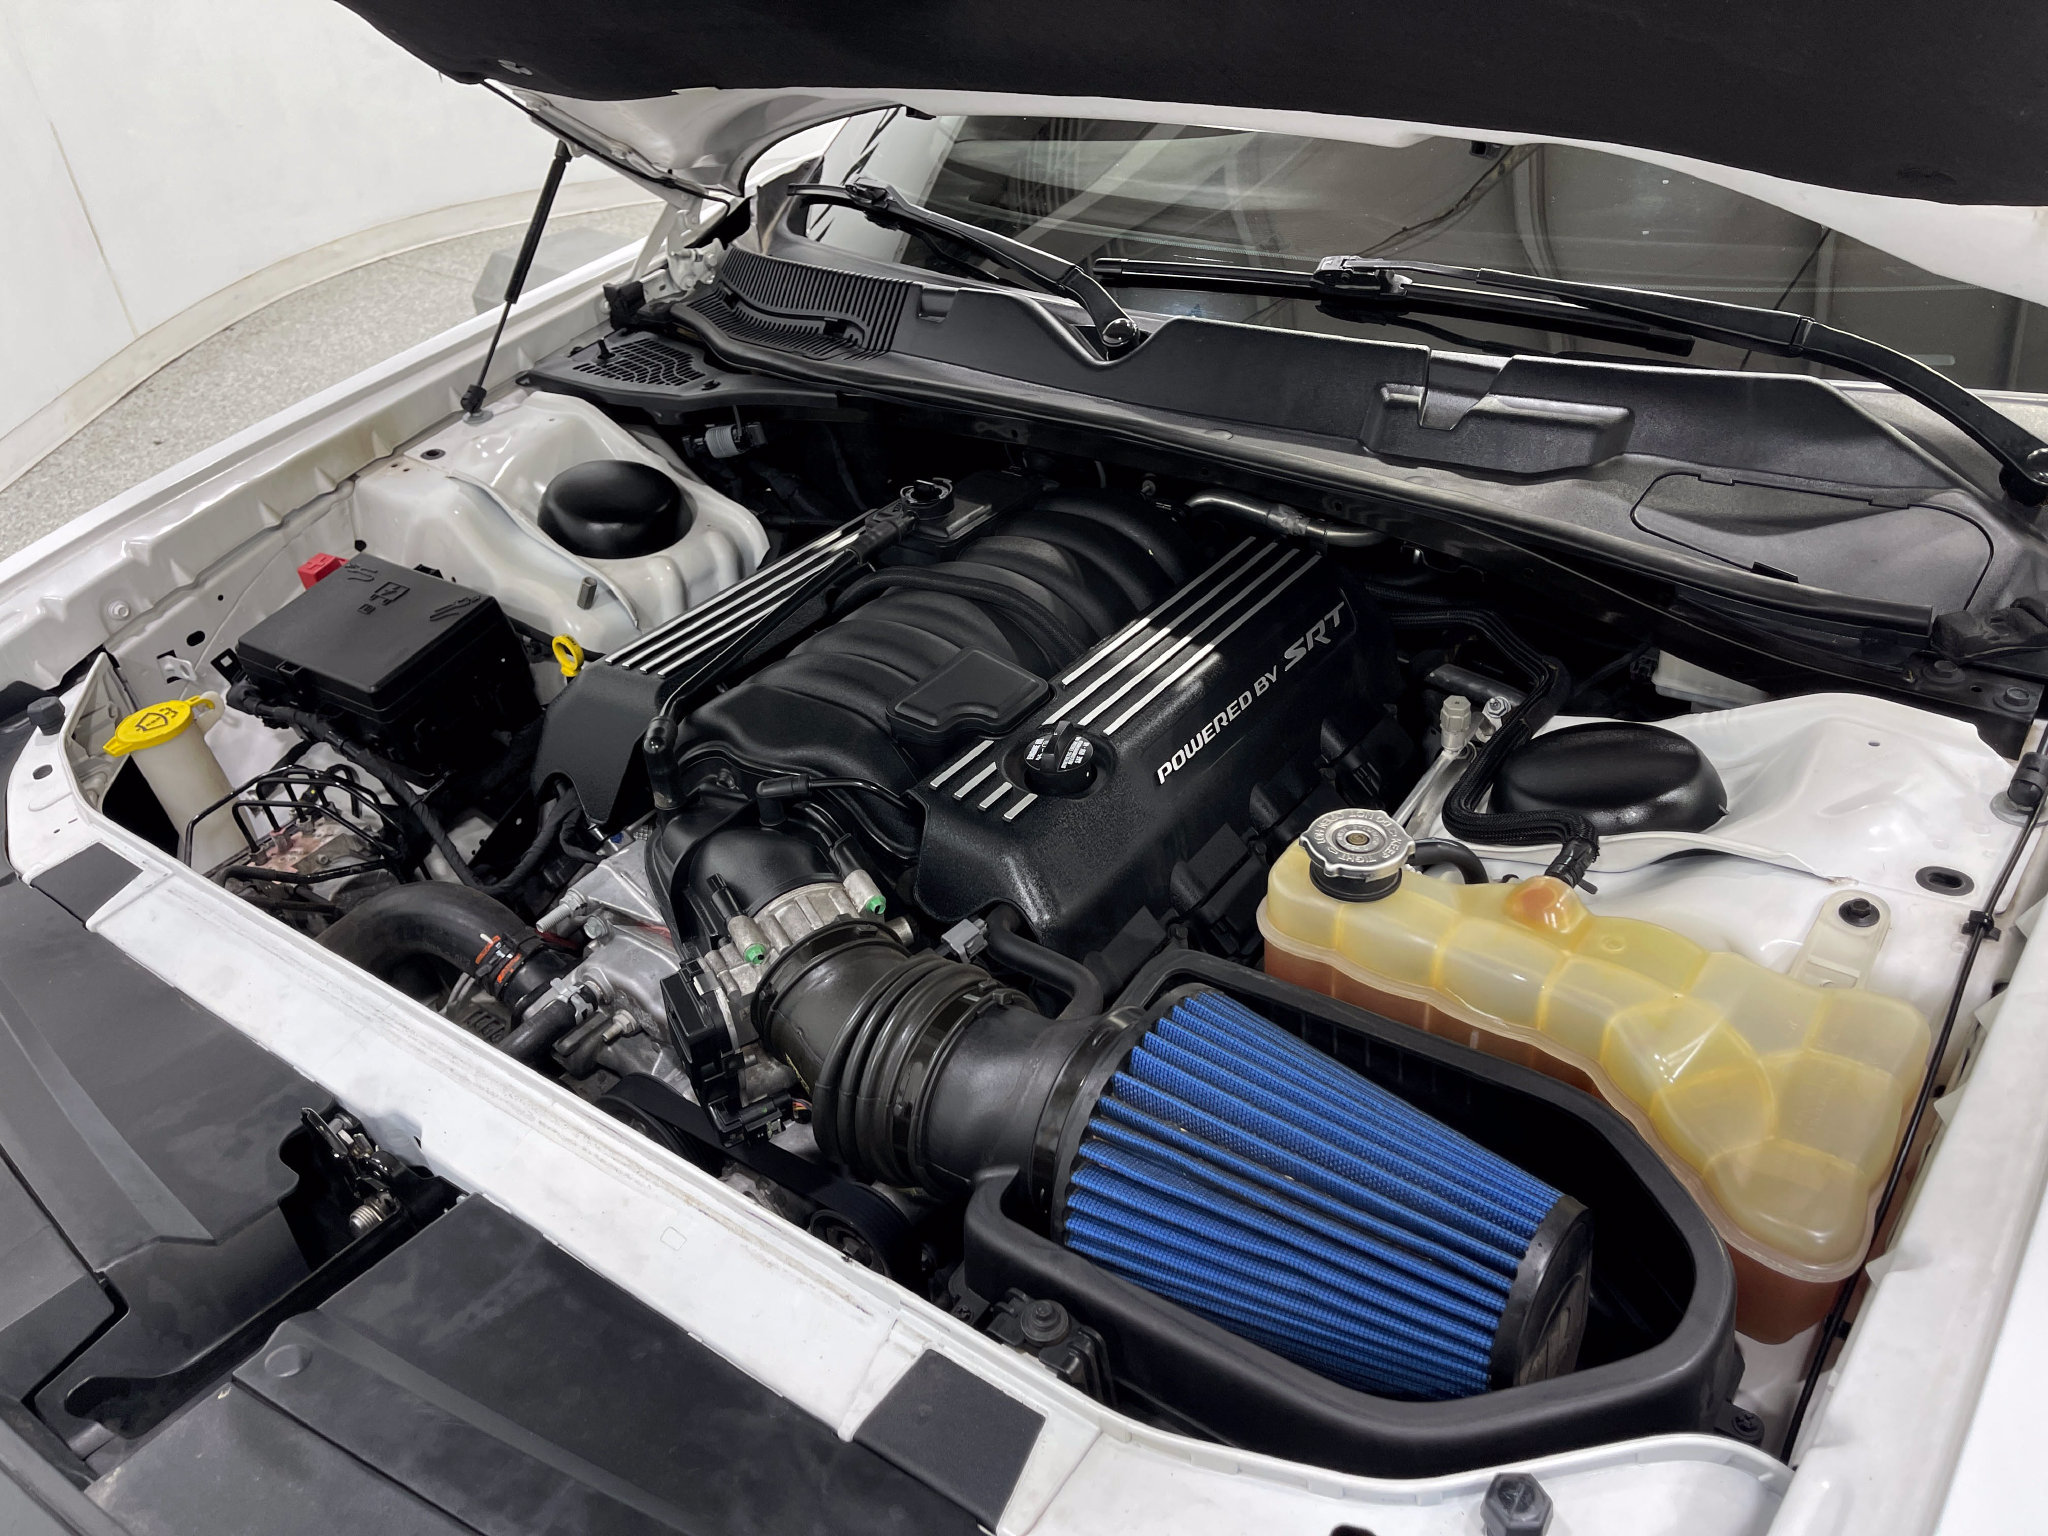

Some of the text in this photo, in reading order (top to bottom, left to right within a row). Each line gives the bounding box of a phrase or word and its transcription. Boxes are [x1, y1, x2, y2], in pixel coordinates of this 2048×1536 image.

[1157, 690, 1253, 785] POWERED
[1254, 665, 1277, 697] BY
[1284, 601, 1345, 672] SRT
[1348, 811, 1374, 820] NOT
[1376, 816, 1392, 828] DO
[1382, 838, 1402, 859] KEEP
[1338, 854, 1377, 863] TIGHT
